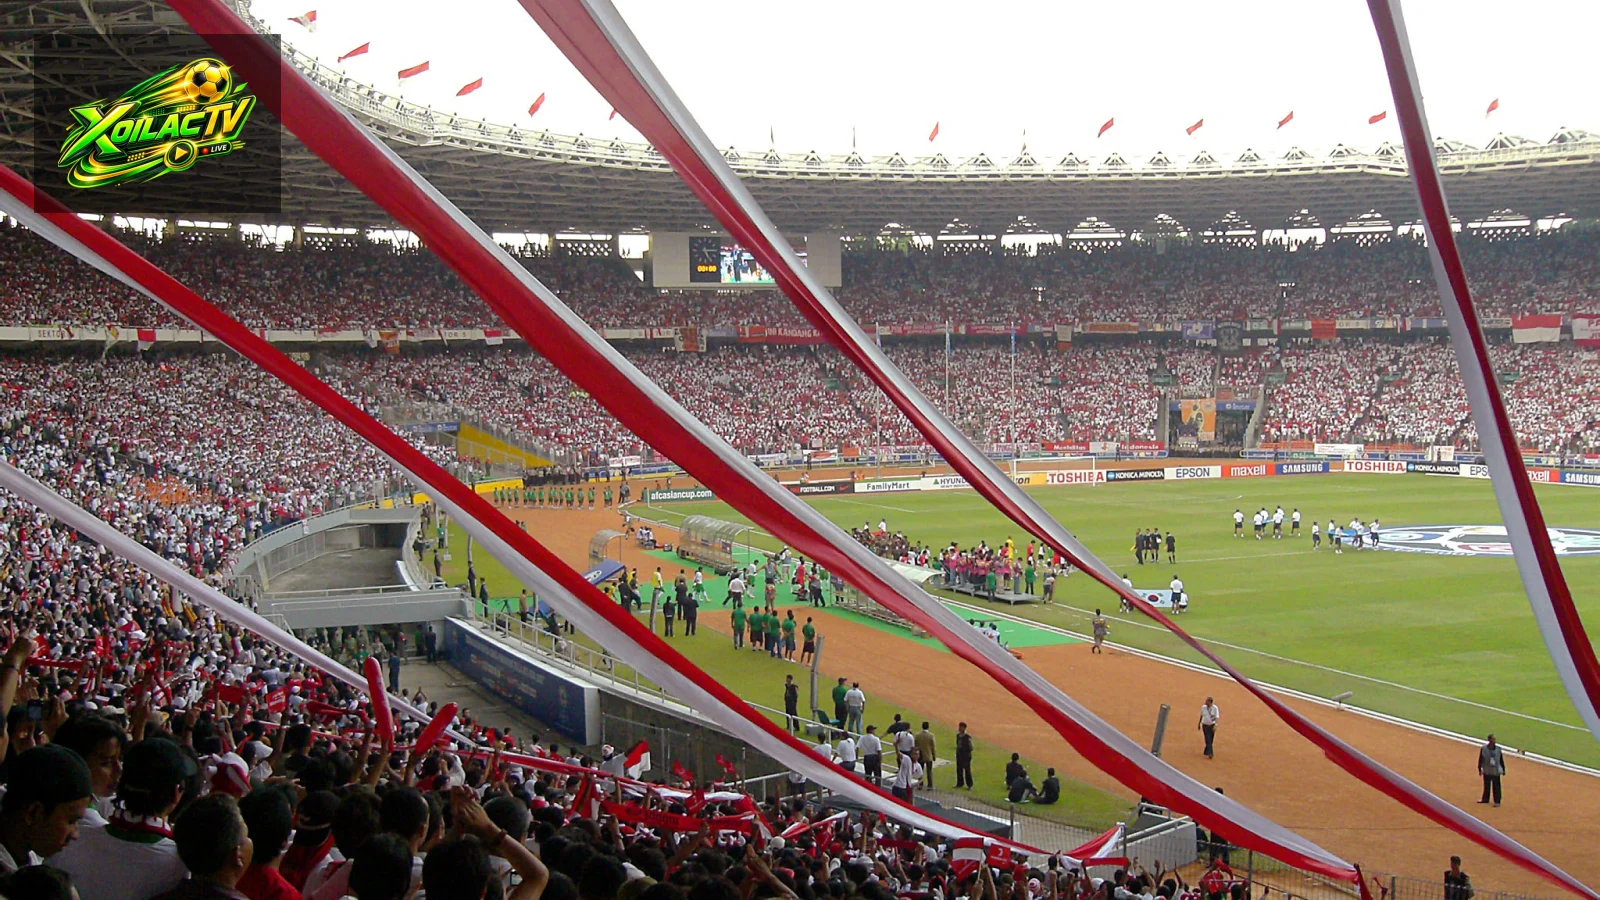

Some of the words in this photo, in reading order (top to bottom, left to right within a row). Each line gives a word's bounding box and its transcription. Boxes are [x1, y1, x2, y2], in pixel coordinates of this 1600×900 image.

[697, 264, 717, 273] 00:00
[1231, 464, 1266, 476] maxell
[1282, 463, 1323, 473] SAMSUNG
[1347, 461, 1405, 472] TOSHIBA
[1414, 464, 1437, 472] KONICA
[1437, 465, 1460, 473] MINOLTA
[1470, 466, 1489, 476] EPS
[1115, 472, 1138, 480] KONICA
[1138, 470, 1164, 478] MINOLTA
[1176, 467, 1210, 478] EPSON
[1527, 470, 1550, 482] axell
[940, 477, 967, 485] HYUND
[1565, 472, 1600, 484] SAMSUN
[866, 482, 910, 491] FamilyMart
[651, 490, 713, 500] afcasiancup.com
